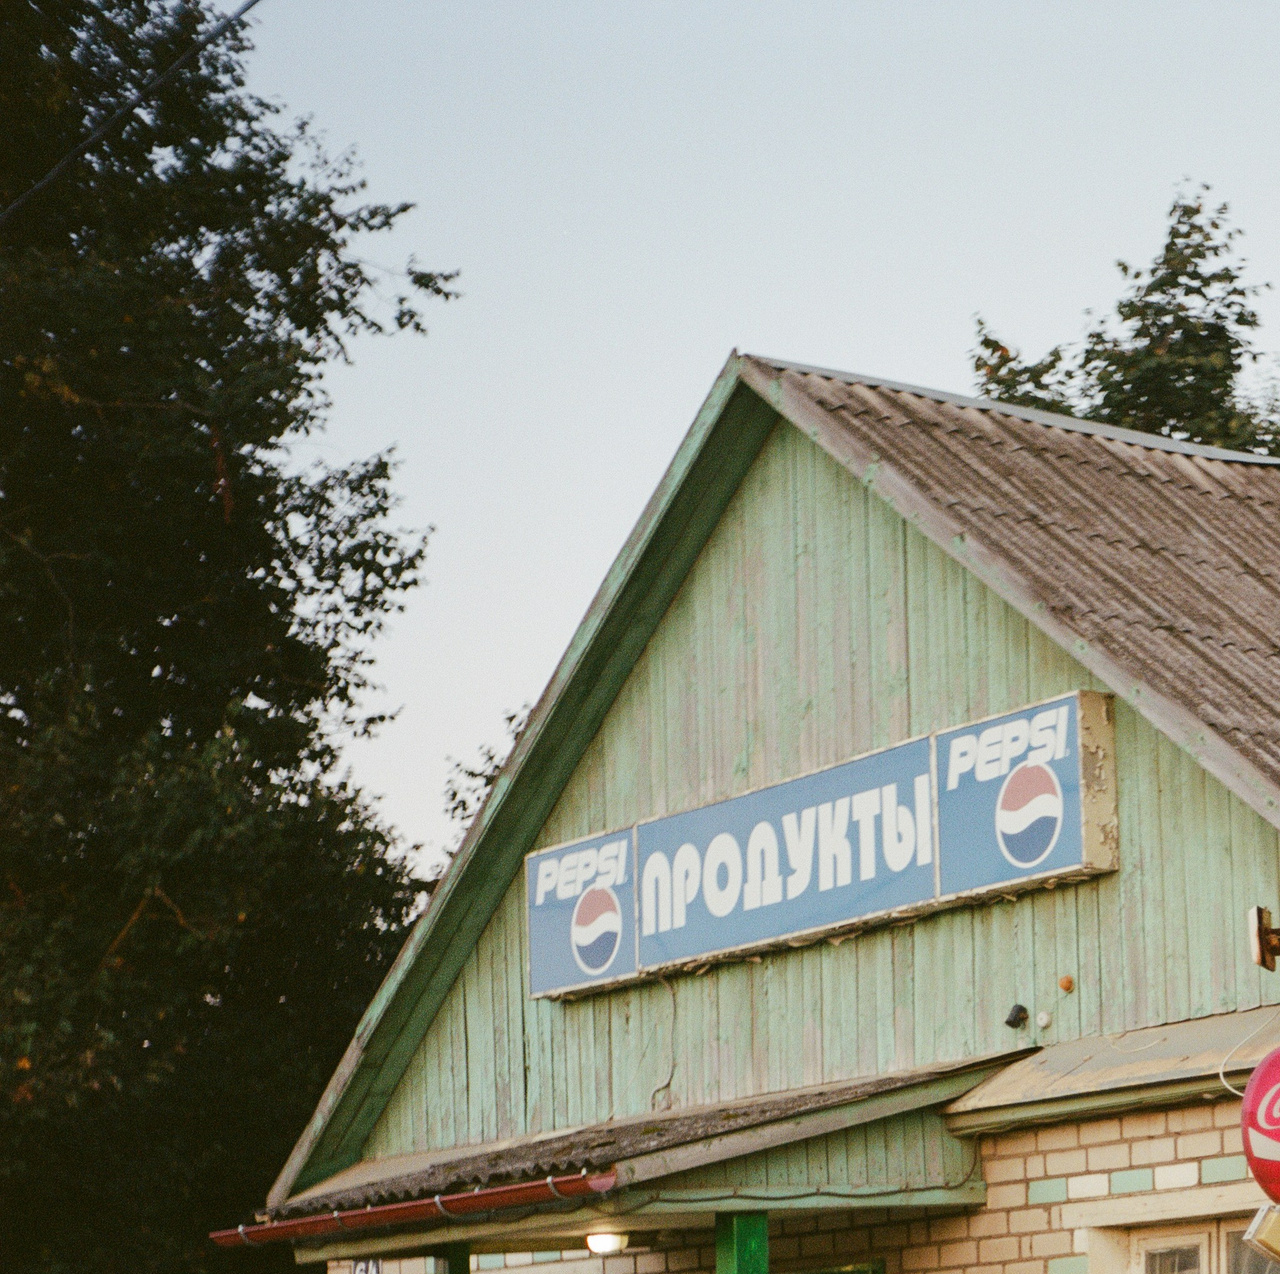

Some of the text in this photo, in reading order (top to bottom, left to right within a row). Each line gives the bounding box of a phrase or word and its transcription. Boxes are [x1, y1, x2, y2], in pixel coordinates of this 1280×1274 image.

[946, 705, 1070, 791] PEPSI
[535, 839, 628, 907] PEPSI
[641, 773, 932, 937] ПРОДУКТЫ
